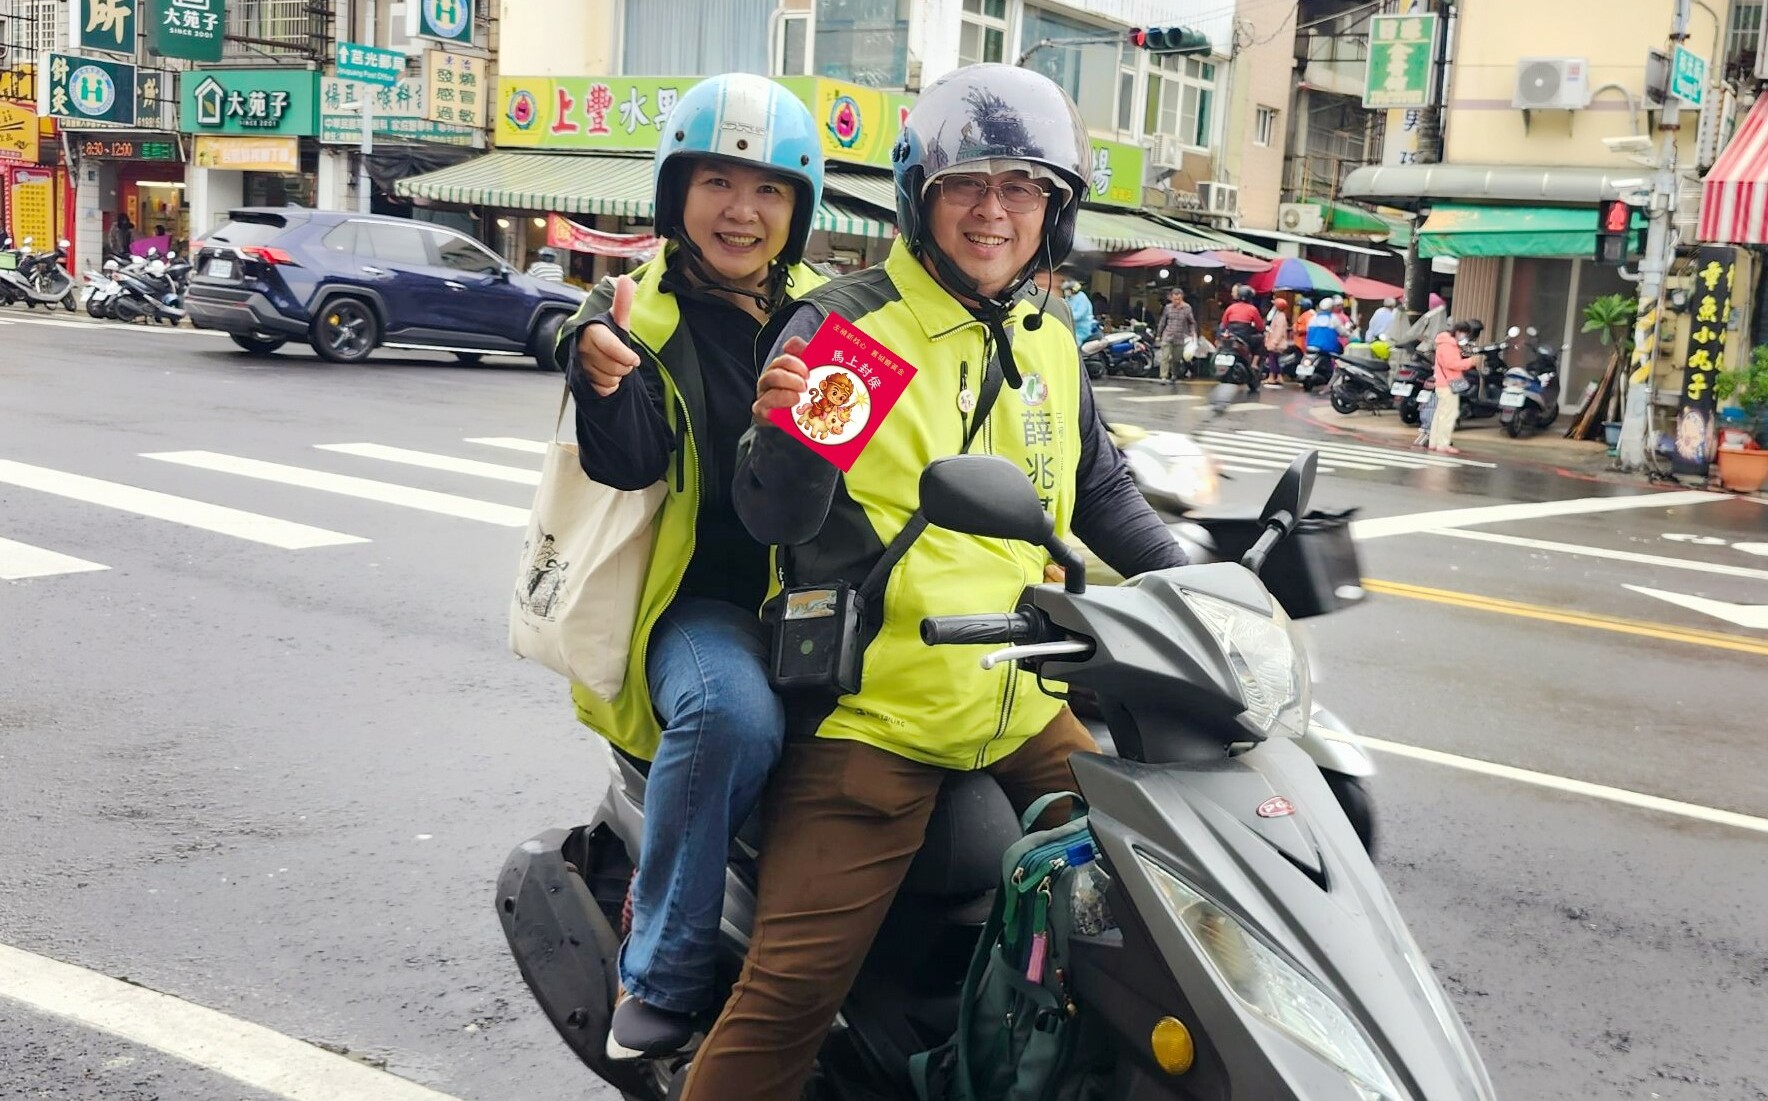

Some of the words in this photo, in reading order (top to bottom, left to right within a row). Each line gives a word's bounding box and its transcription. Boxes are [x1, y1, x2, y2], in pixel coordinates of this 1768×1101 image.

[163, 7, 219, 31] 大苑子
[168, 27, 192, 36] SINCE
[194, 30, 213, 39] 2001
[51, 57, 70, 115] 針灸
[436, 68, 476, 87] 發燒
[226, 90, 288, 118] 大苑子
[436, 87, 476, 105] 感冒
[436, 105, 476, 124] 過敏
[111, 142, 133, 156] 12:00
[1687, 260, 1723, 400] 章魚小丸子
